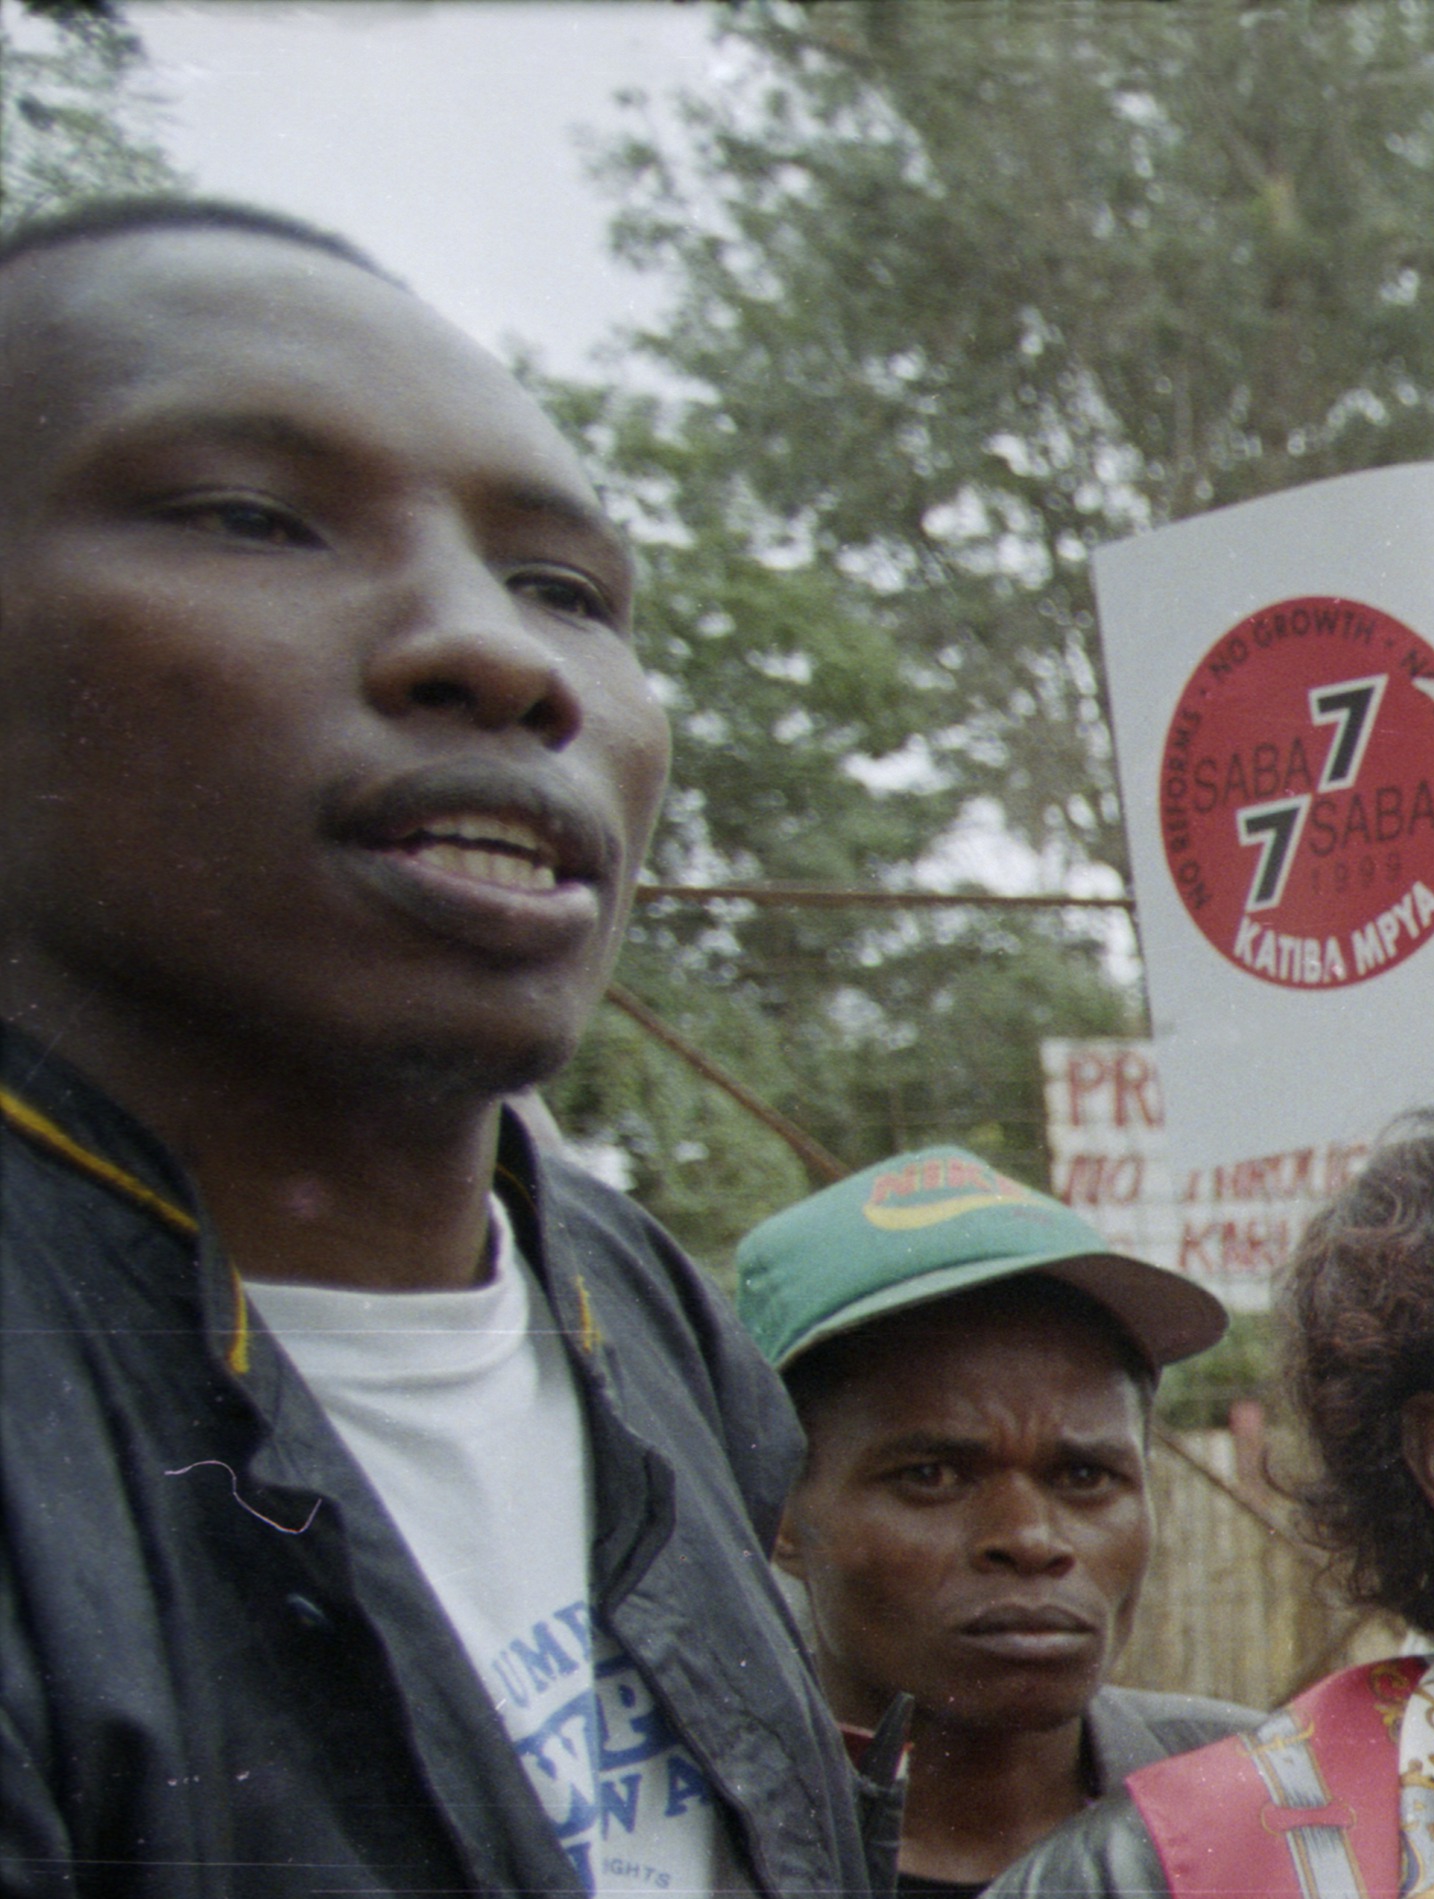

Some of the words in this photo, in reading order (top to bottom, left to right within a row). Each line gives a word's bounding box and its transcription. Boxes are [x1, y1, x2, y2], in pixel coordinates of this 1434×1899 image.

[1209, 639, 1249, 681] NO
[1251, 607, 1377, 649] GROWTH
[1308, 673, 1389, 794] 7
[1166, 709, 1203, 853] REFORMS
[1192, 736, 1313, 816] SABA
[1178, 859, 1213, 909] NO
[1236, 794, 1312, 914] 7
[1233, 915, 1348, 985] KATIBA
